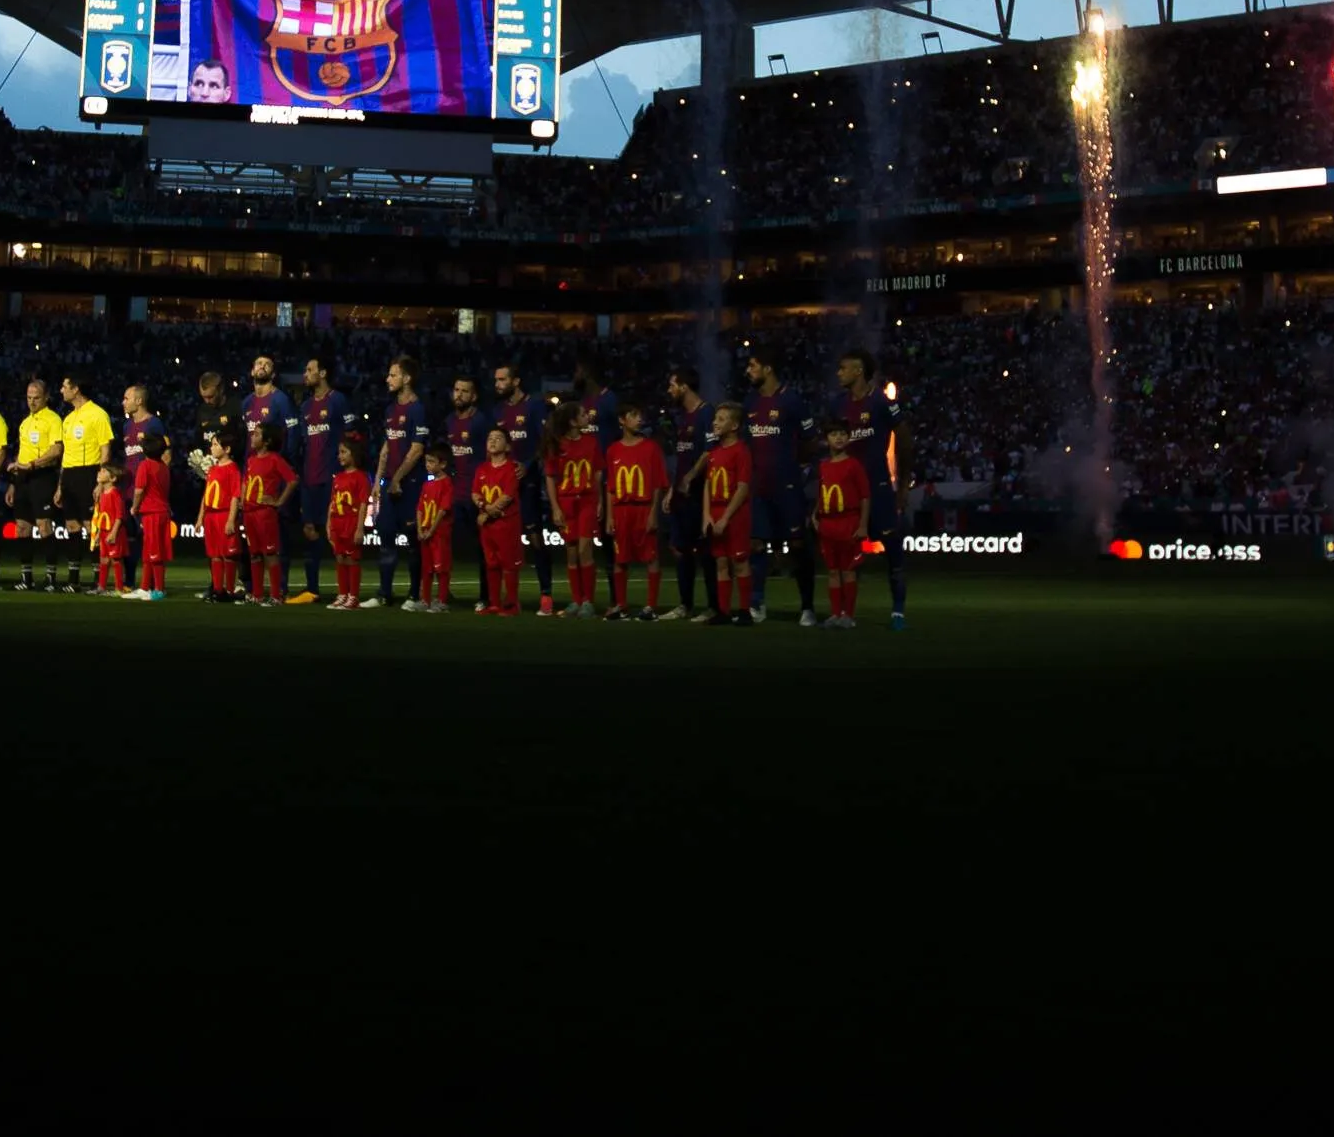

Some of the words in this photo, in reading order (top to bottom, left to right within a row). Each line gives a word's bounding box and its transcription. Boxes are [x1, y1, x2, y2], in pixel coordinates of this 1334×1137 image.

[1159, 258, 1173, 274] FC
[1178, 254, 1243, 272] BARCELONA
[893, 275, 931, 291] MADRID
[935, 274, 947, 288] CF
[1148, 538, 1262, 560] priceess
